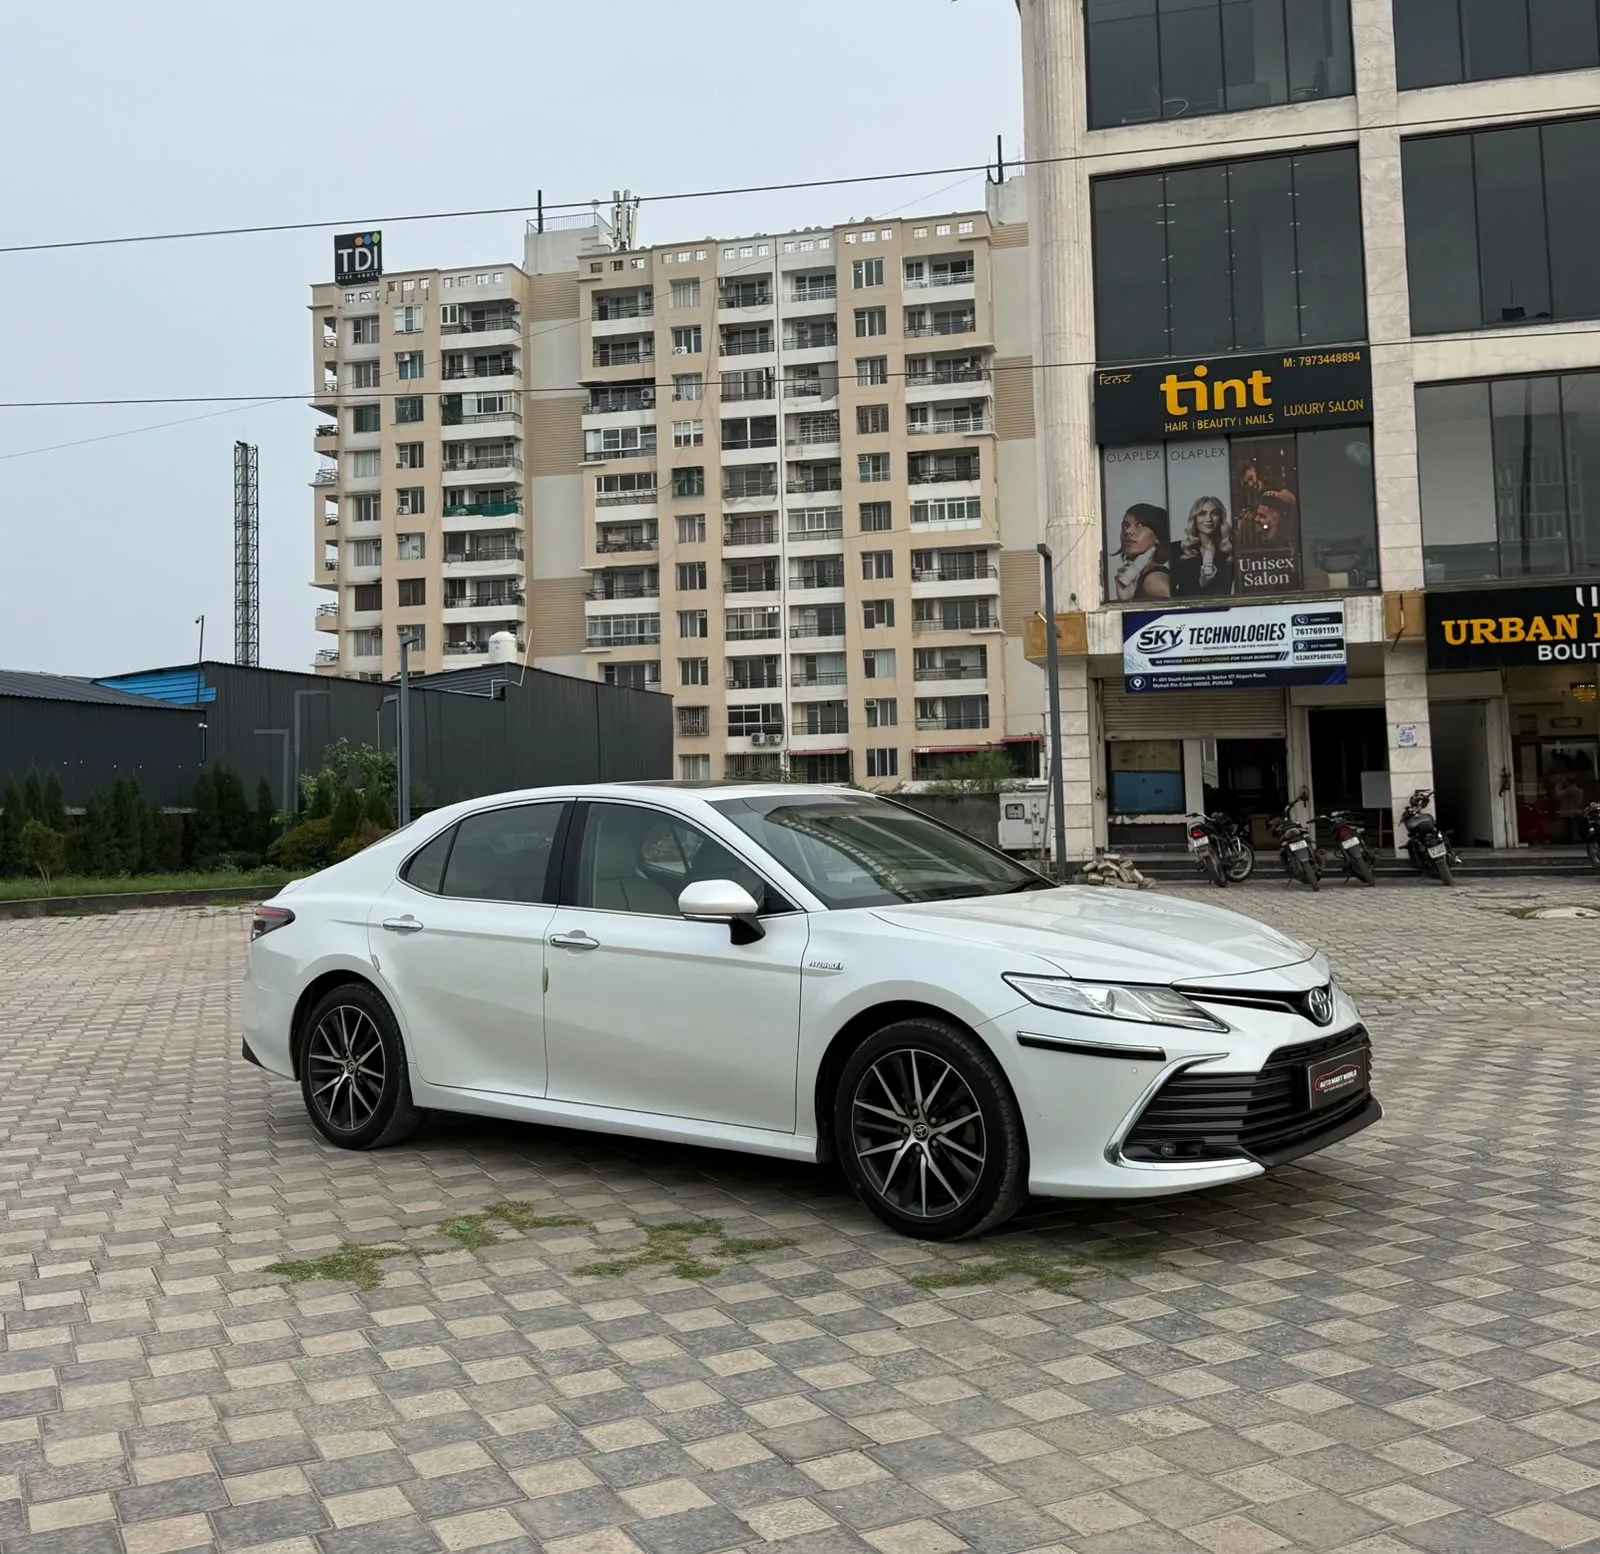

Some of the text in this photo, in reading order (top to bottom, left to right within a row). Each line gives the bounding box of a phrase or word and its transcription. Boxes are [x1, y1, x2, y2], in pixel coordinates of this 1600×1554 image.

[338, 246, 378, 273] TDI
[1283, 351, 1361, 368] M: 7973448894
[1159, 365, 1273, 416] tint
[1283, 398, 1364, 417] LUXURY SALON
[1165, 413, 1274, 433] HAIR BEAUTY NAILS
[1106, 450, 1160, 464] OLAPLEX
[1170, 447, 1226, 461] OLAPLEX
[1239, 556, 1294, 572] Unisex
[1244, 571, 1290, 587] Salon
[1140, 623, 1286, 646] SKY TECHNOLOGIES
[1295, 626, 1339, 636] 7617691191
[1441, 614, 1580, 646] URBAN
[1537, 642, 1600, 661] BOUT
